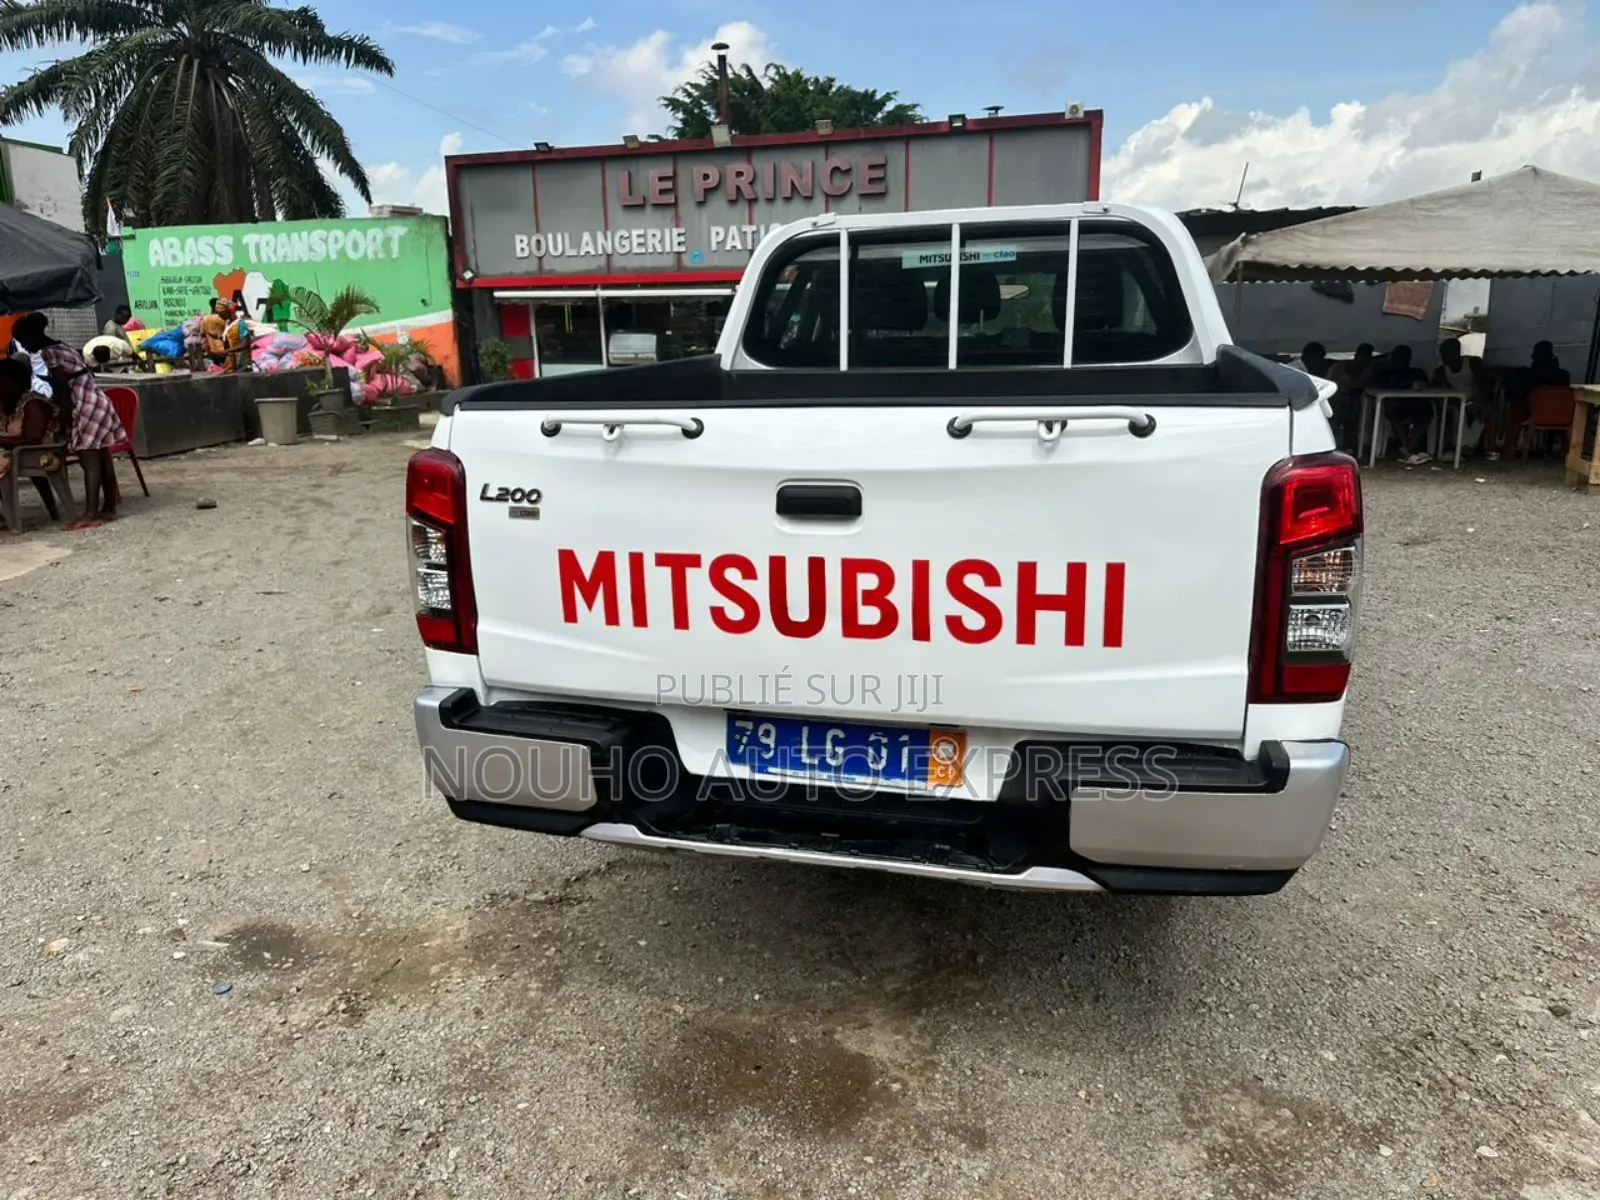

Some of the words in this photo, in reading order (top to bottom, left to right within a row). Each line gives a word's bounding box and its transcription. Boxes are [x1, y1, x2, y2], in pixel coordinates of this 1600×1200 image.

[620, 169, 677, 206] LE
[692, 156, 888, 203] PRINCE
[149, 235, 234, 267] ABASS
[243, 226, 407, 264] TRANSPORT
[514, 227, 687, 258] BOULANGERIE
[709, 222, 780, 251] PATI
[919, 251, 981, 264] MITSUISHI
[480, 483, 543, 504] L200
[557, 549, 1126, 648] MITSUBISHI
[735, 719, 776, 759] 79
[801, 726, 846, 767] LG
[867, 732, 911, 773] 01
